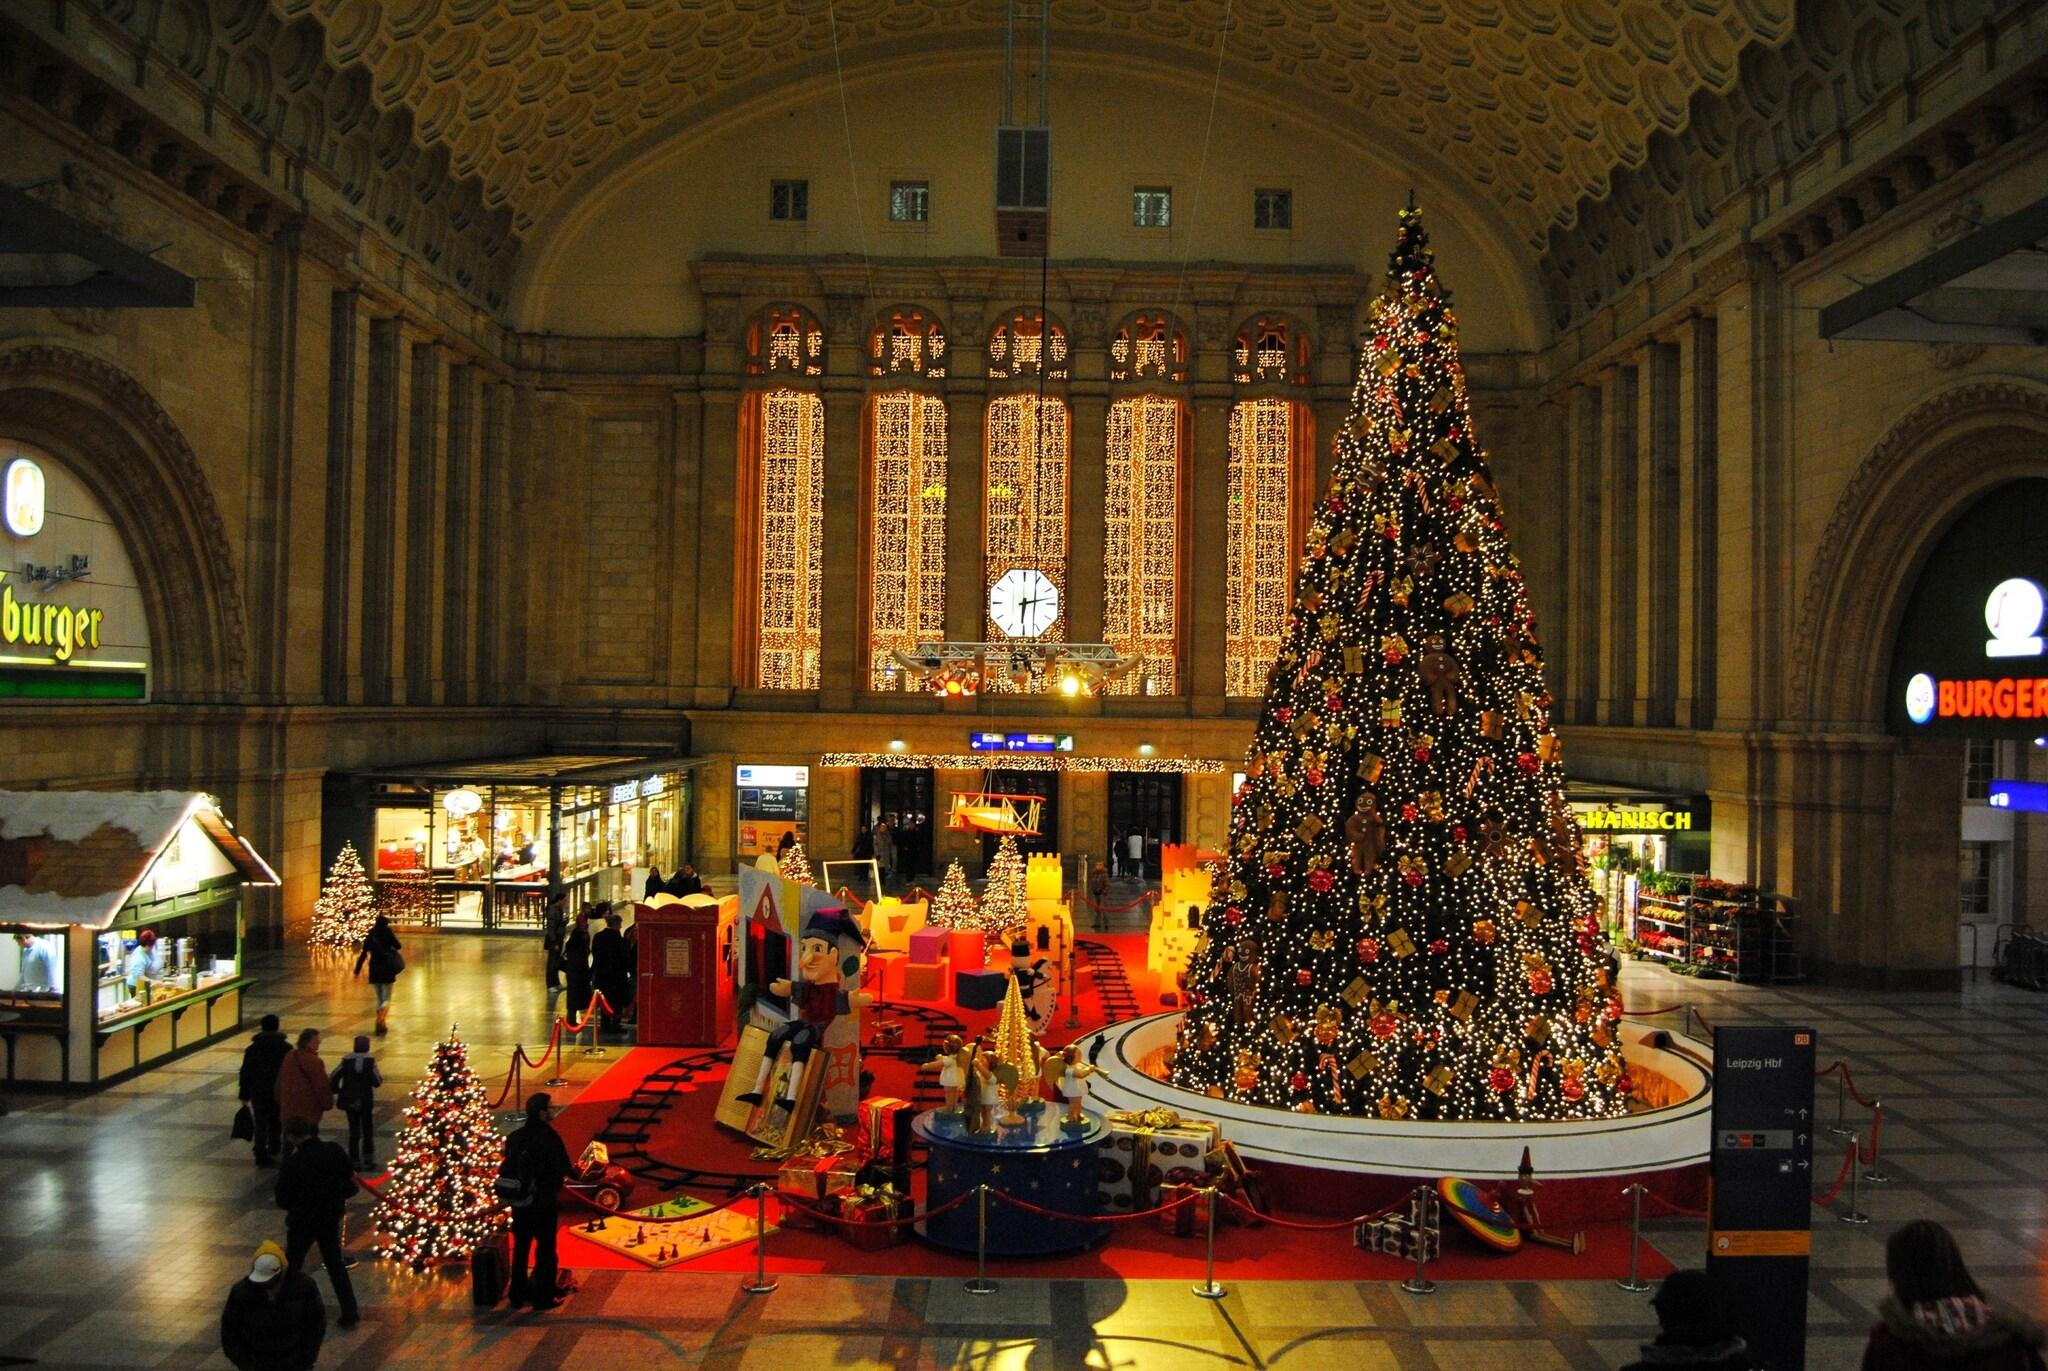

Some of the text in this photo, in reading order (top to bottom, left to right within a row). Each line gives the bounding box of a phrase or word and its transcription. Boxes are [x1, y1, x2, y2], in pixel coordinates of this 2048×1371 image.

[0, 572, 104, 660] burger
[1938, 678, 2048, 718] BURGER
[1726, 1057, 1783, 1070] Leipzig Hbf
